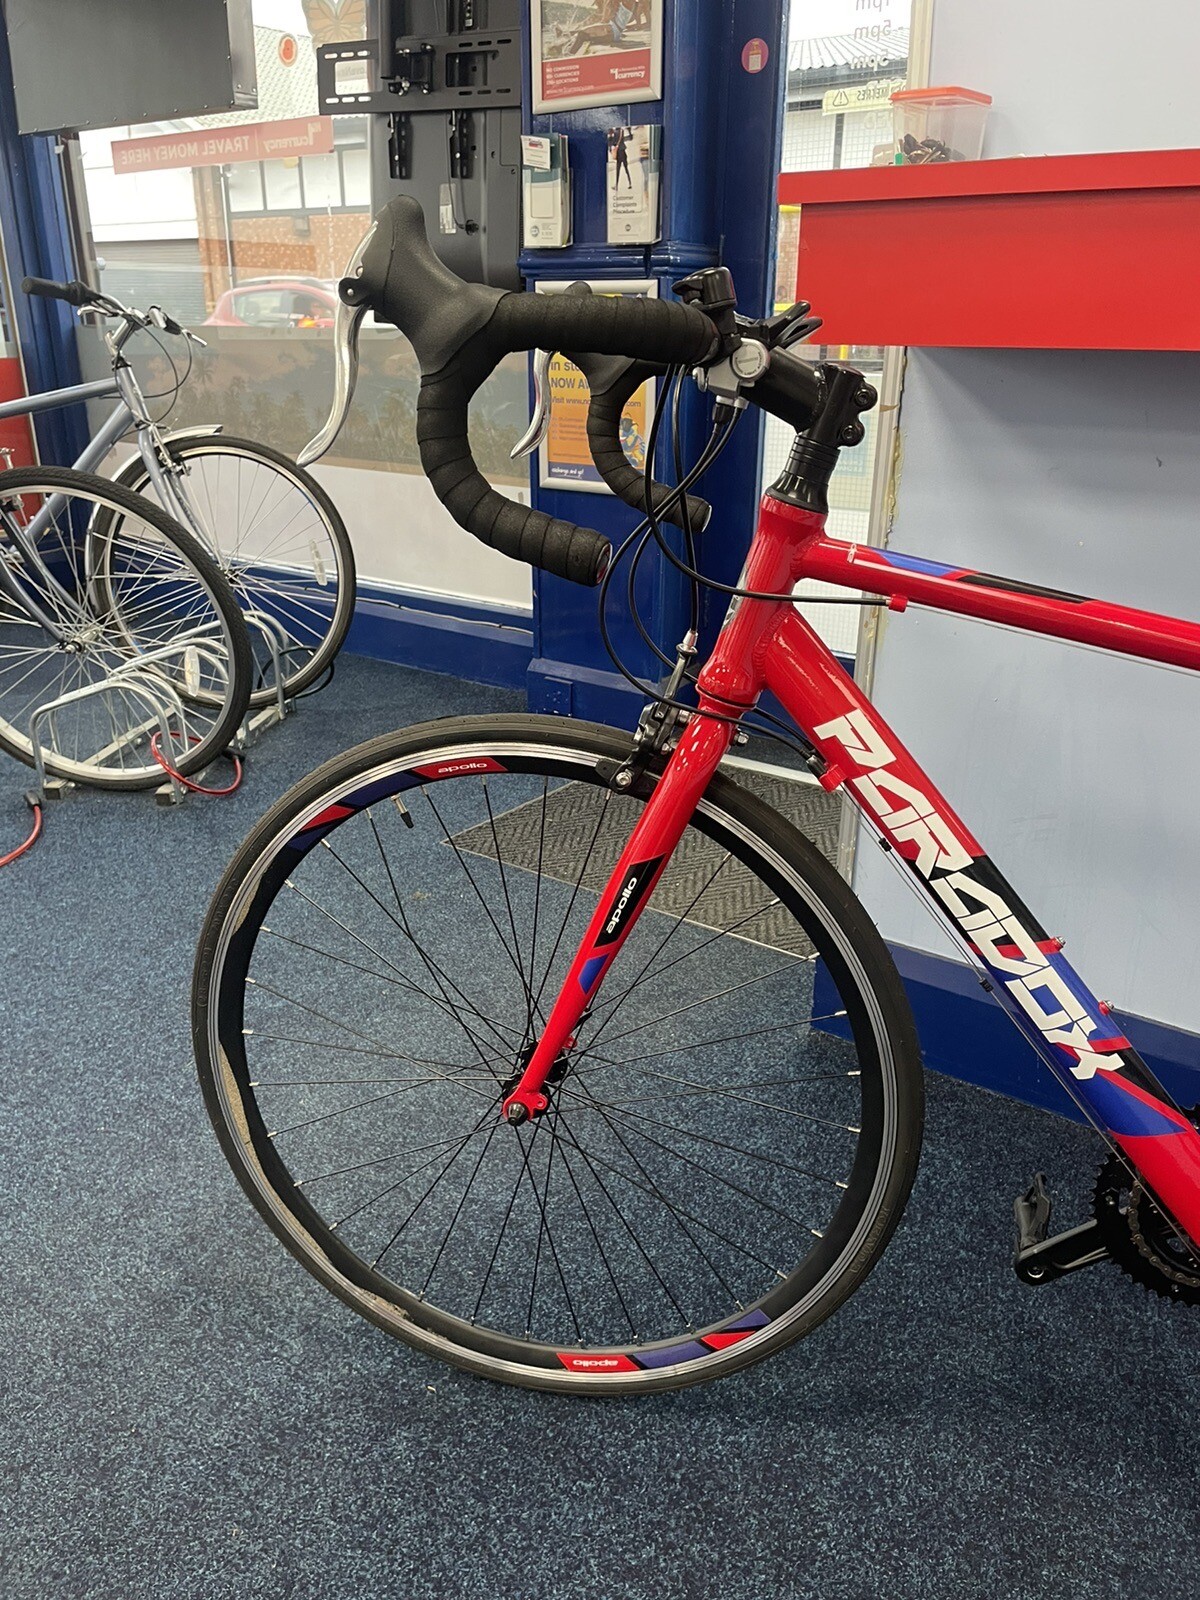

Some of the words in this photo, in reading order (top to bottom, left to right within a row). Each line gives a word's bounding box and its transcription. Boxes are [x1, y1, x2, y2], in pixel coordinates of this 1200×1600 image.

[551, 377, 576, 388] NOW
[438, 762, 488, 774] apollo
[813, 708, 1125, 1080] PARADOX
[606, 877, 637, 934] apollo
[573, 1359, 619, 1367] apollo
